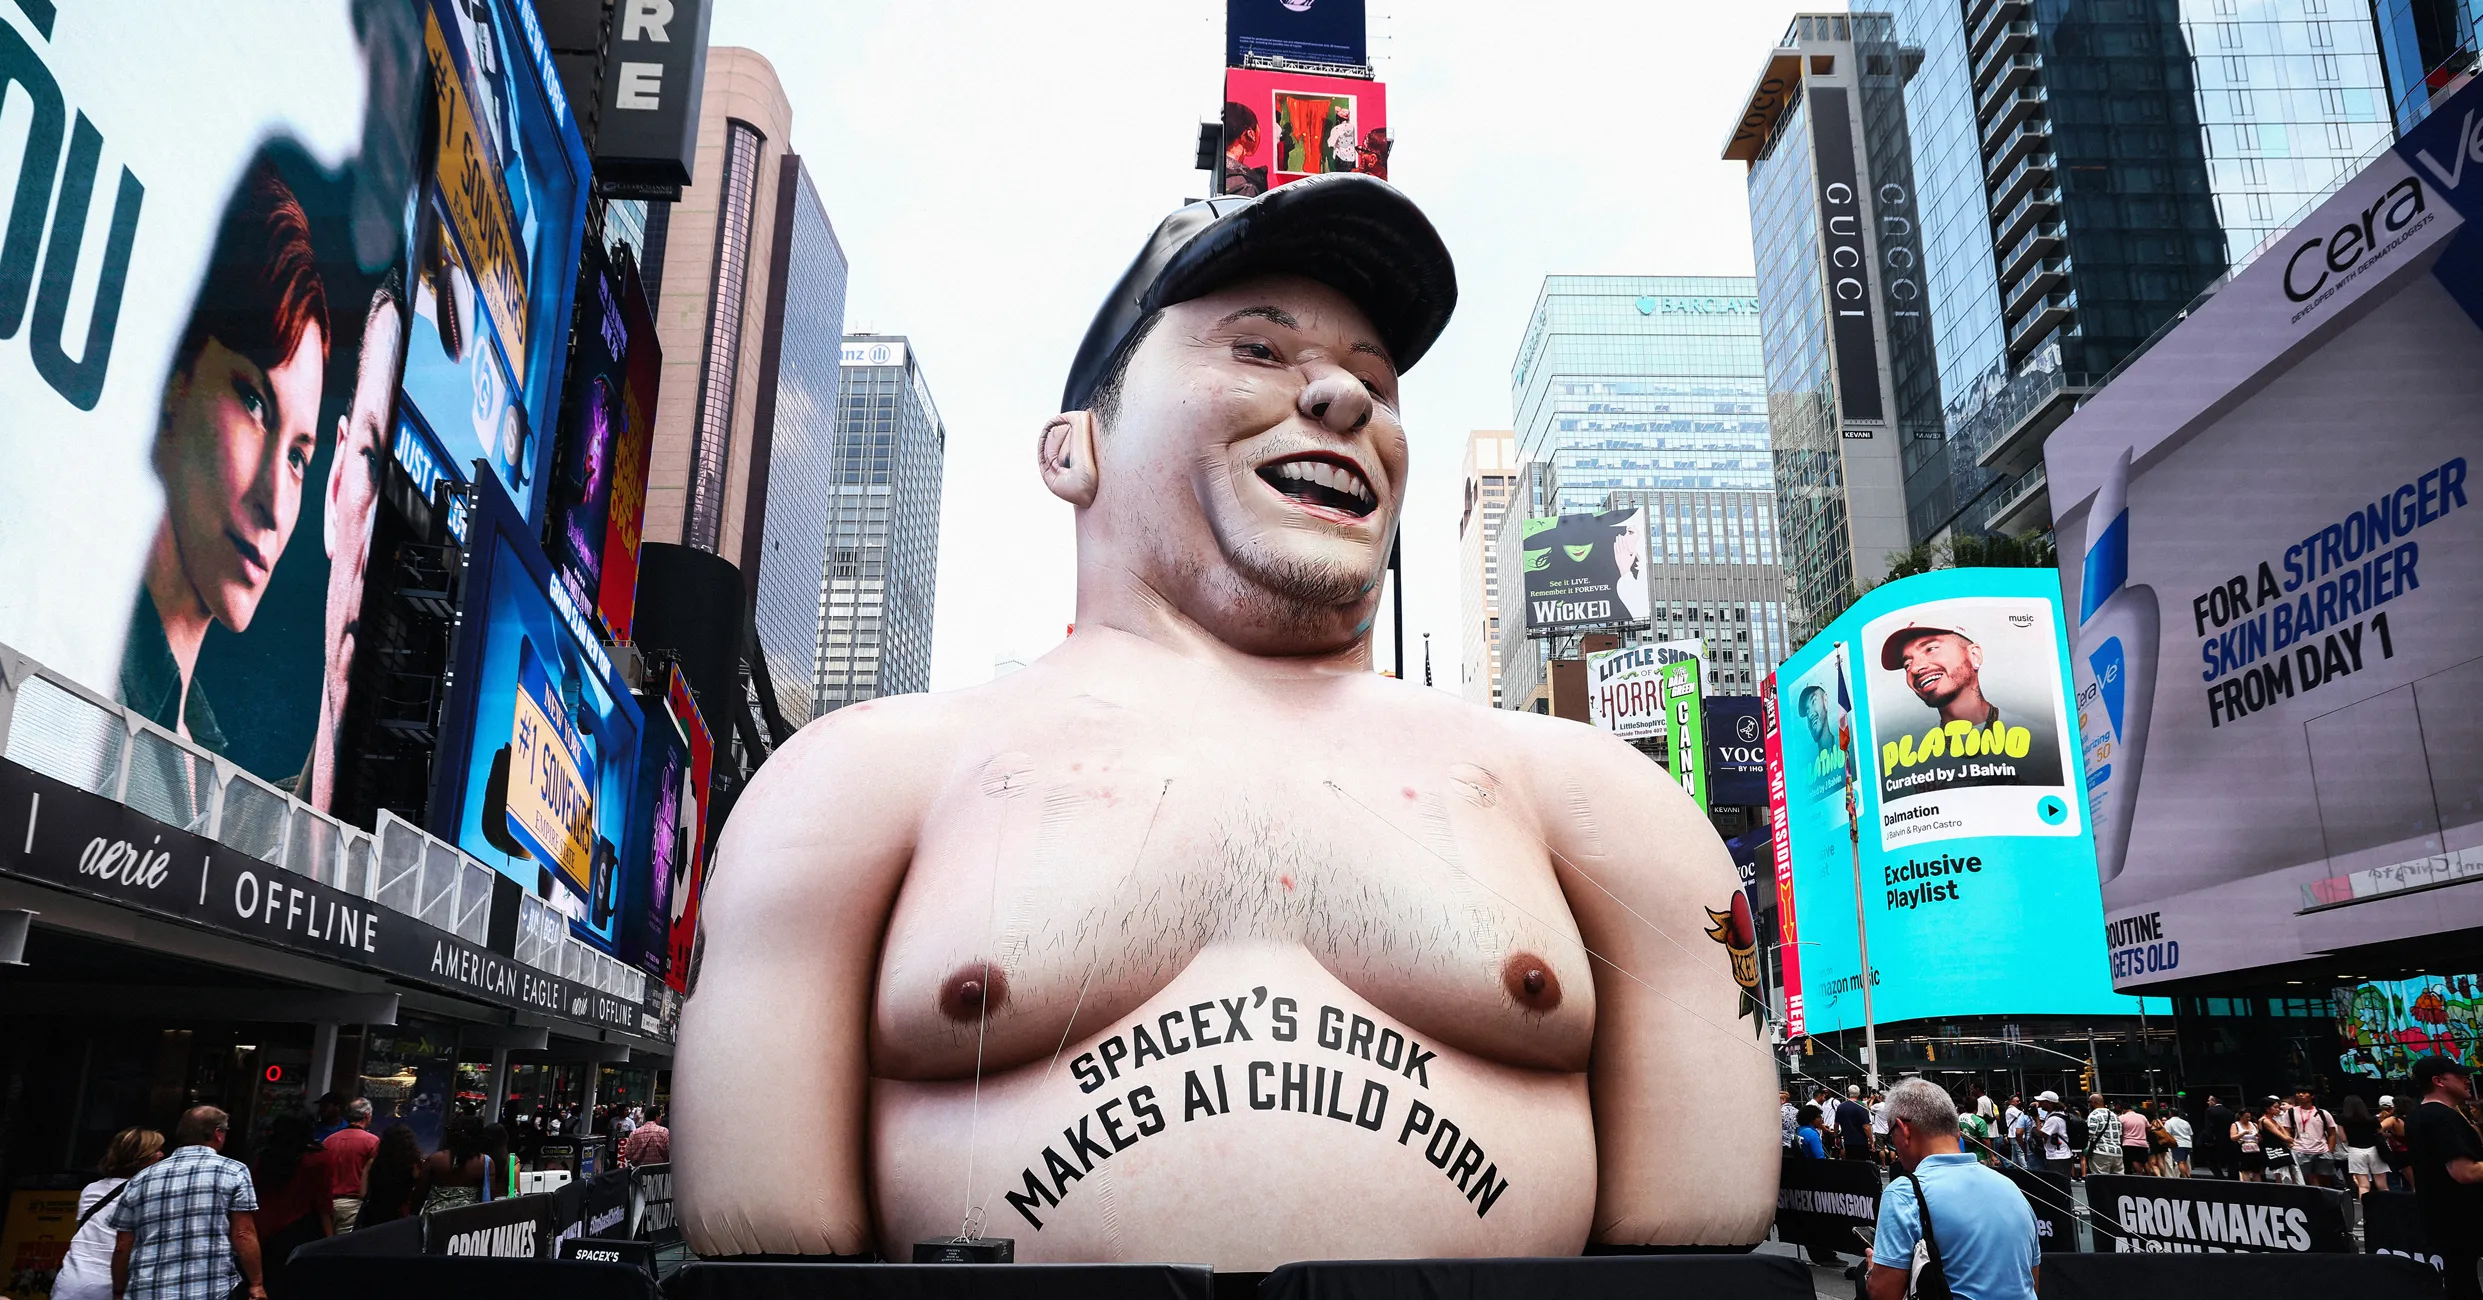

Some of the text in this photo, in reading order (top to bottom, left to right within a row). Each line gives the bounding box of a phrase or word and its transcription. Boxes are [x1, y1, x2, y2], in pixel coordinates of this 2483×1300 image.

[543, 49, 566, 127] YORK
[1826, 182, 1865, 317] GUCCI
[2292, 213, 2435, 325] DEVELOPED WITH DERMATOLOGISTS
[1661, 298, 1760, 314] BARCLAYS
[394, 426, 432, 492] JUST
[2193, 456, 2468, 638] FOR A STRONGER
[1530, 588, 1567, 597] Remember
[1574, 584, 1611, 594] FOREVER.
[1571, 577, 1590, 585] LIVE.
[549, 573, 572, 623] GRAND
[571, 608, 587, 650] SLAM
[586, 630, 600, 664] NEW
[598, 647, 611, 684] YORK
[2009, 614, 2034, 622] music
[2202, 541, 2420, 682] SKIN BARRIER
[1600, 648, 1697, 682] LITTLE SHO
[2207, 611, 2394, 728] FROM DAY 1
[543, 682, 582, 767] NEW YORK
[1882, 719, 2031, 777] PLATINO
[1886, 763, 2016, 793] Curated by J Balvin
[2096, 743, 2111, 763] 50
[518, 709, 592, 856] #1 SOUVENIRS
[535, 810, 576, 870] EMPIRE STATE
[1773, 805, 1790, 881] INSIDE!
[1884, 804, 1940, 827] Dalmation
[1889, 827, 1906, 840] Balvin
[1906, 826, 1912, 835] &
[1913, 823, 1932, 836] Ryan
[1933, 819, 1963, 831] Castro
[79, 834, 171, 889] aerie
[1885, 854, 1982, 886] Exclusive
[235, 871, 378, 953] OFFLINE
[1887, 879, 1960, 911] Playlist
[431, 941, 559, 1009] AMERICAN EAGLE
[1816, 977, 1848, 998] mazon
[2113, 946, 2145, 979] GETS
[2147, 940, 2180, 973] OLD
[571, 991, 587, 1016] aerie
[599, 997, 632, 1026] OFFLINE
[1069, 986, 1438, 1095] SPACEX'S GROK
[1004, 1060, 1510, 1232] MAKES AI CHILD PORN
[492, 1219, 536, 1258] MAKES
[2117, 1194, 2312, 1252] GROK MAKES
[575, 1249, 619, 1263] SPACEX'S
